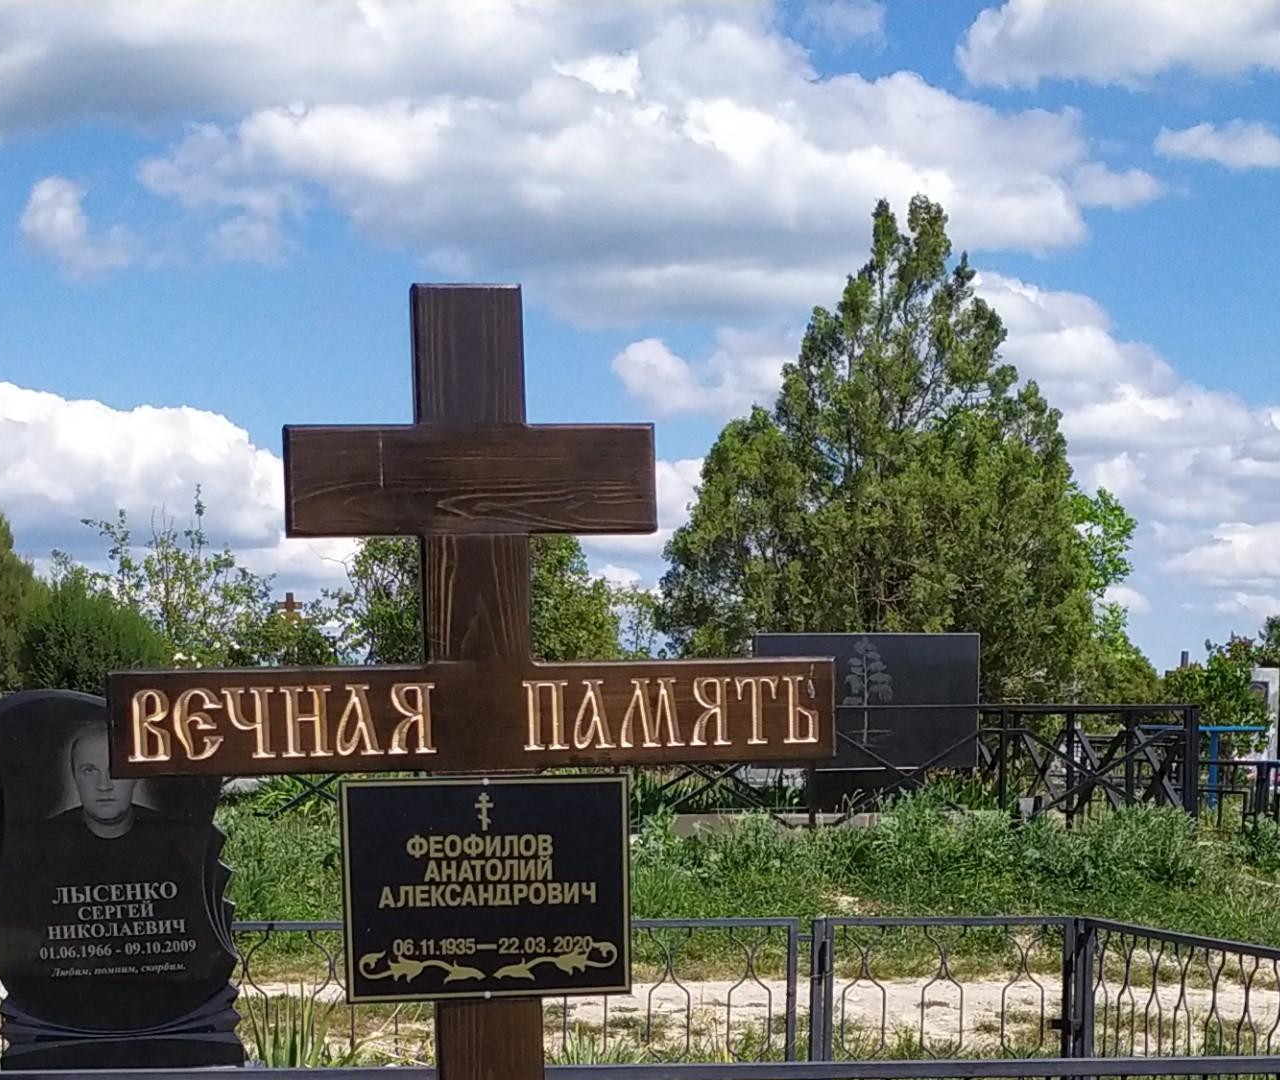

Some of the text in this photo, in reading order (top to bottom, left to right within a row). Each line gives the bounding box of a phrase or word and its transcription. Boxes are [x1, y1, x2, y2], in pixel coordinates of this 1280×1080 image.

[128, 676, 819, 762] ВЕЧНАЯ ПАМЯТЬ
[406, 834, 554, 858] ФЕОФИЛОВ
[424, 855, 553, 882] АНАТОЛИЙ
[52, 881, 178, 905] ЛЫСЕНКО
[378, 882, 597, 908] АЛЕКСАНДРОВИЧ
[78, 901, 155, 921] СЕРГЕЙ
[47, 919, 186, 940] НИКОЛАЕВИЧ
[40, 943, 112, 960] 01.06.1966
[125, 939, 197, 955] 09.10.2009
